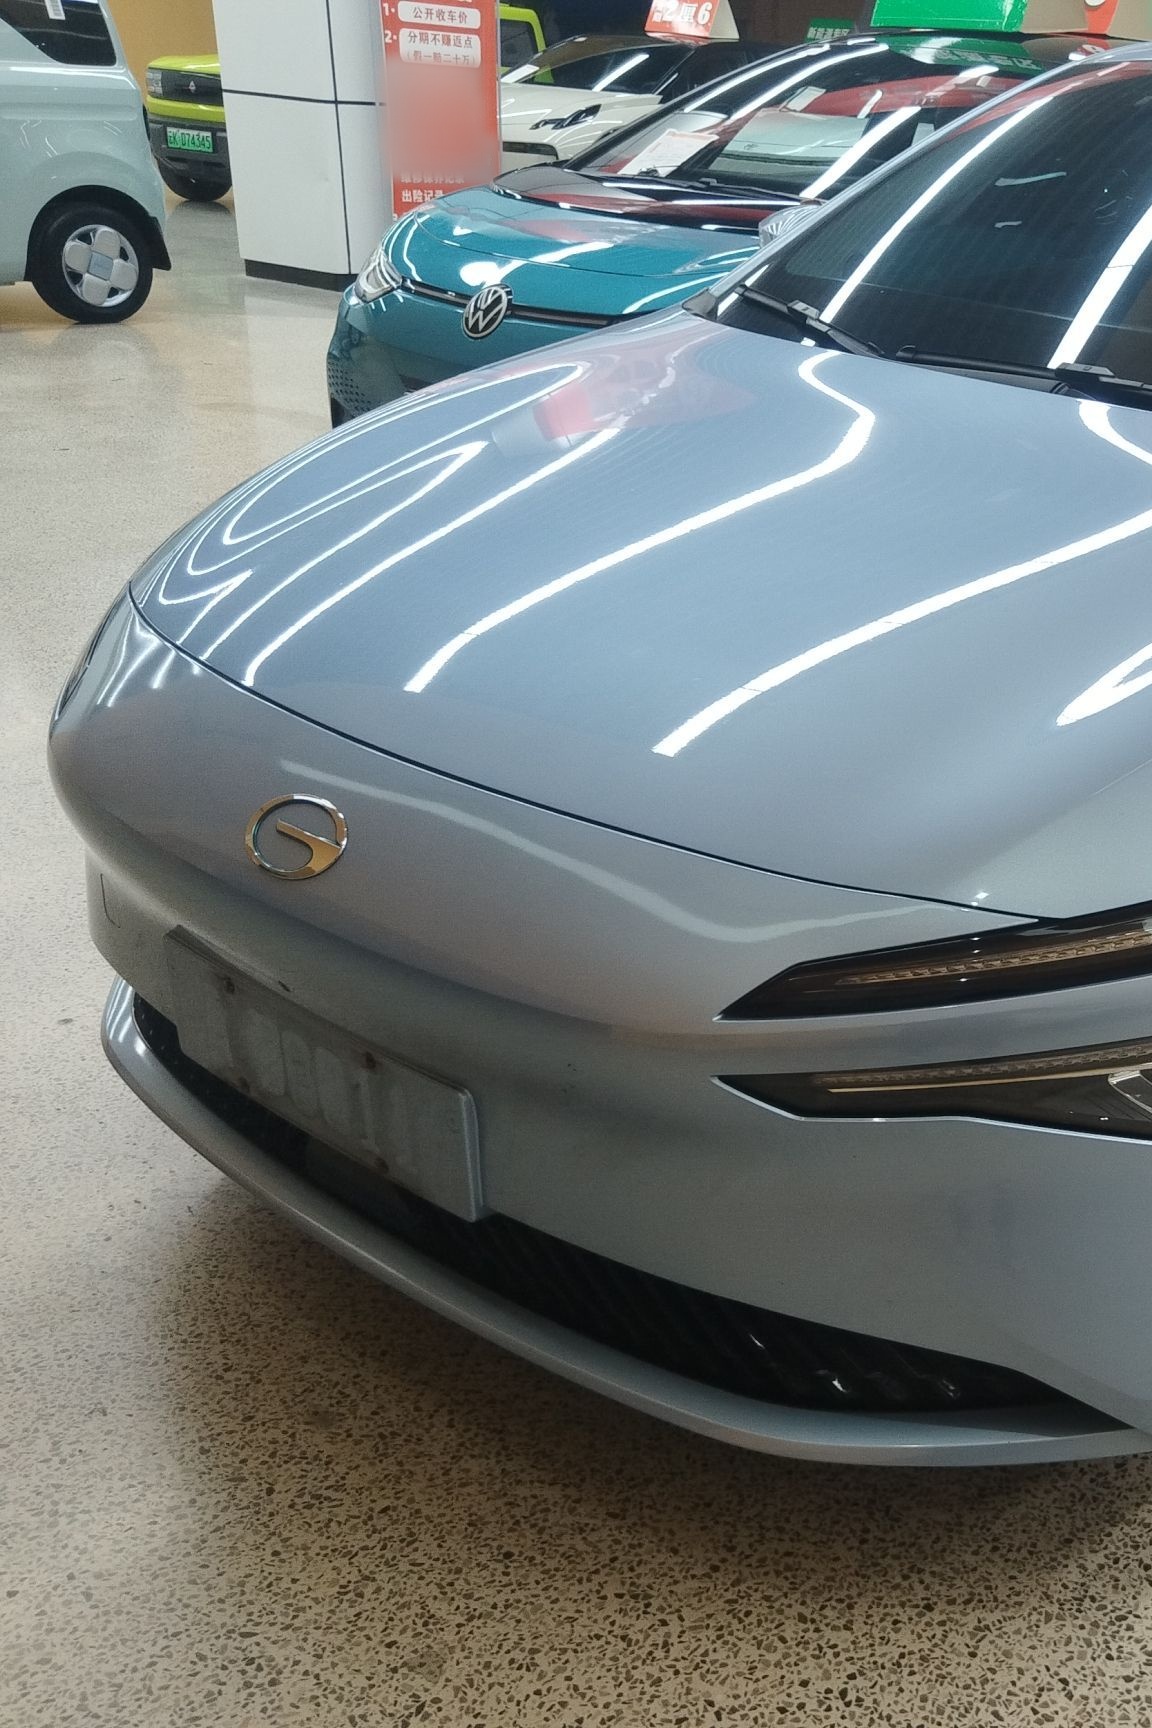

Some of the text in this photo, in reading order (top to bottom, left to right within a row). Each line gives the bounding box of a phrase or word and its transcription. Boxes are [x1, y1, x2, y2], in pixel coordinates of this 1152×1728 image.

[413, 7, 468, 24] 公开收车价
